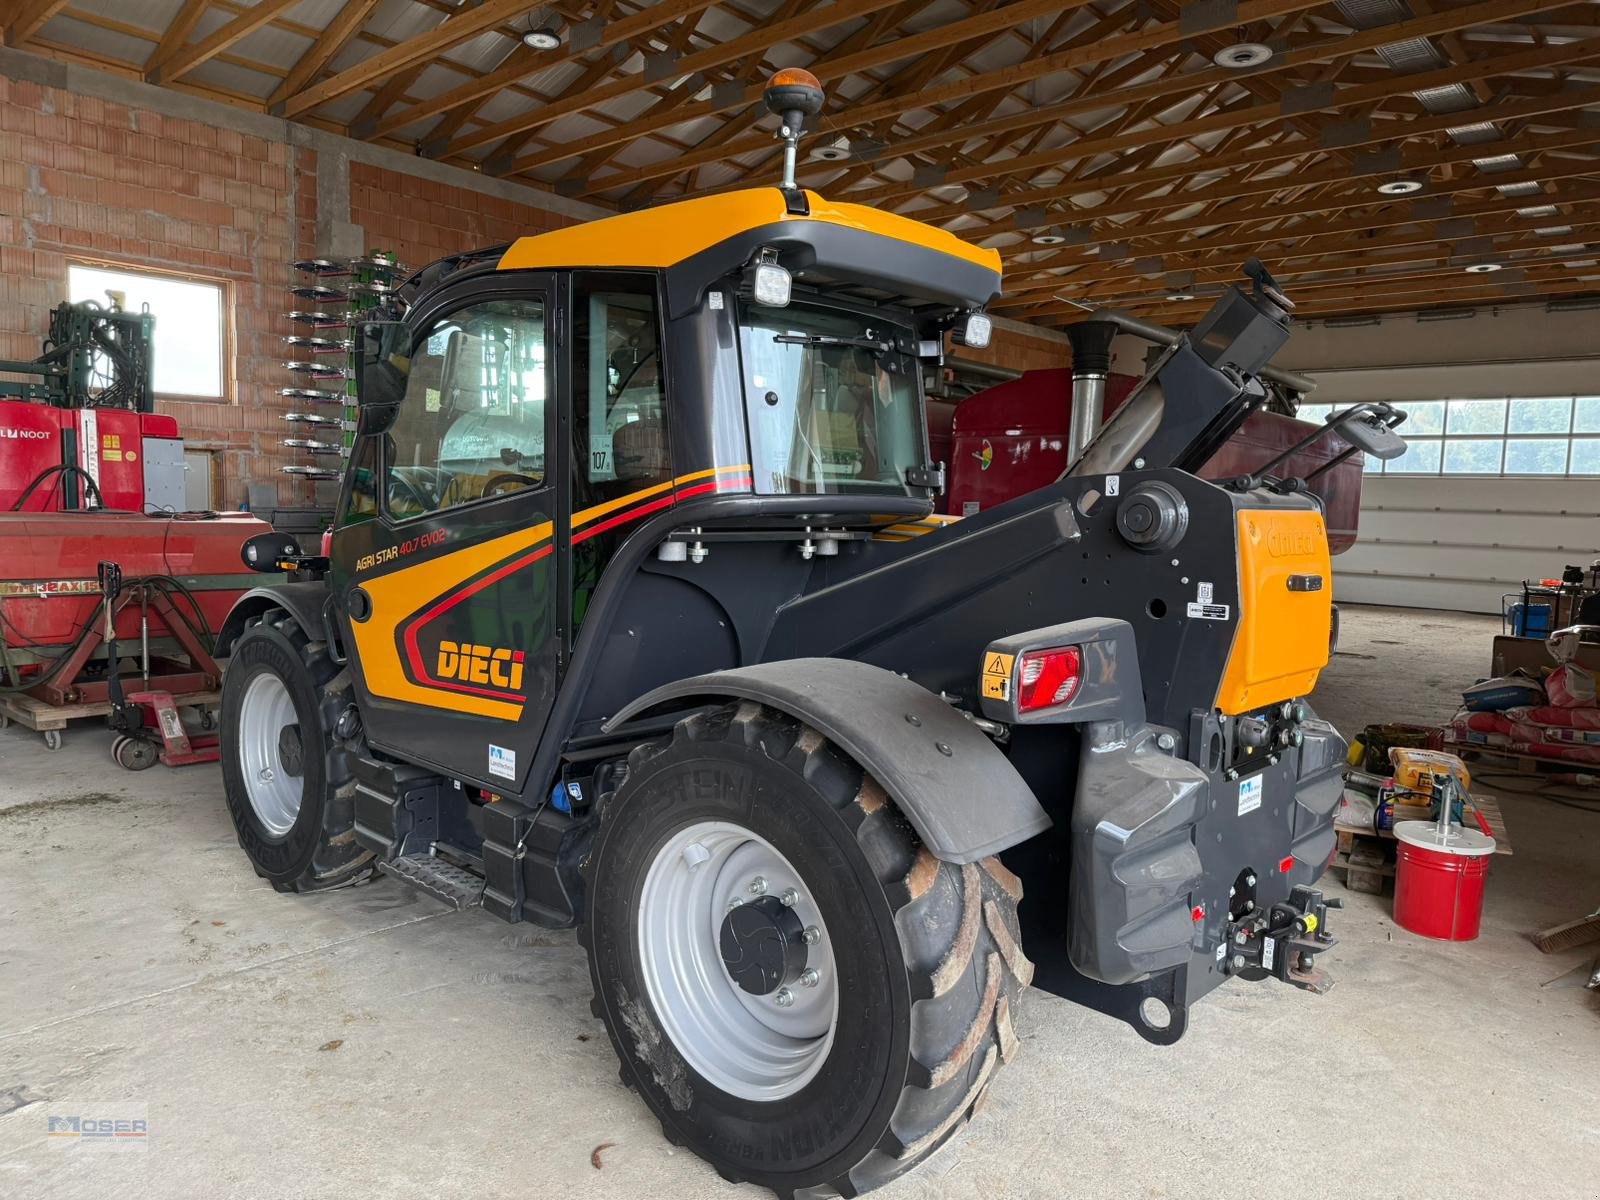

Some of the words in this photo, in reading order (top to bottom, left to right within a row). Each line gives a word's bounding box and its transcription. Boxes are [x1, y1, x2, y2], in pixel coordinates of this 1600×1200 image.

[20, 431, 51, 439] NOOT
[592, 451, 606, 470] 107
[356, 553, 375, 572] AGRI
[376, 545, 399, 565] STAR
[399, 537, 420, 555] 40.7
[420, 527, 447, 548] EVO2
[437, 640, 525, 690] DIECI
